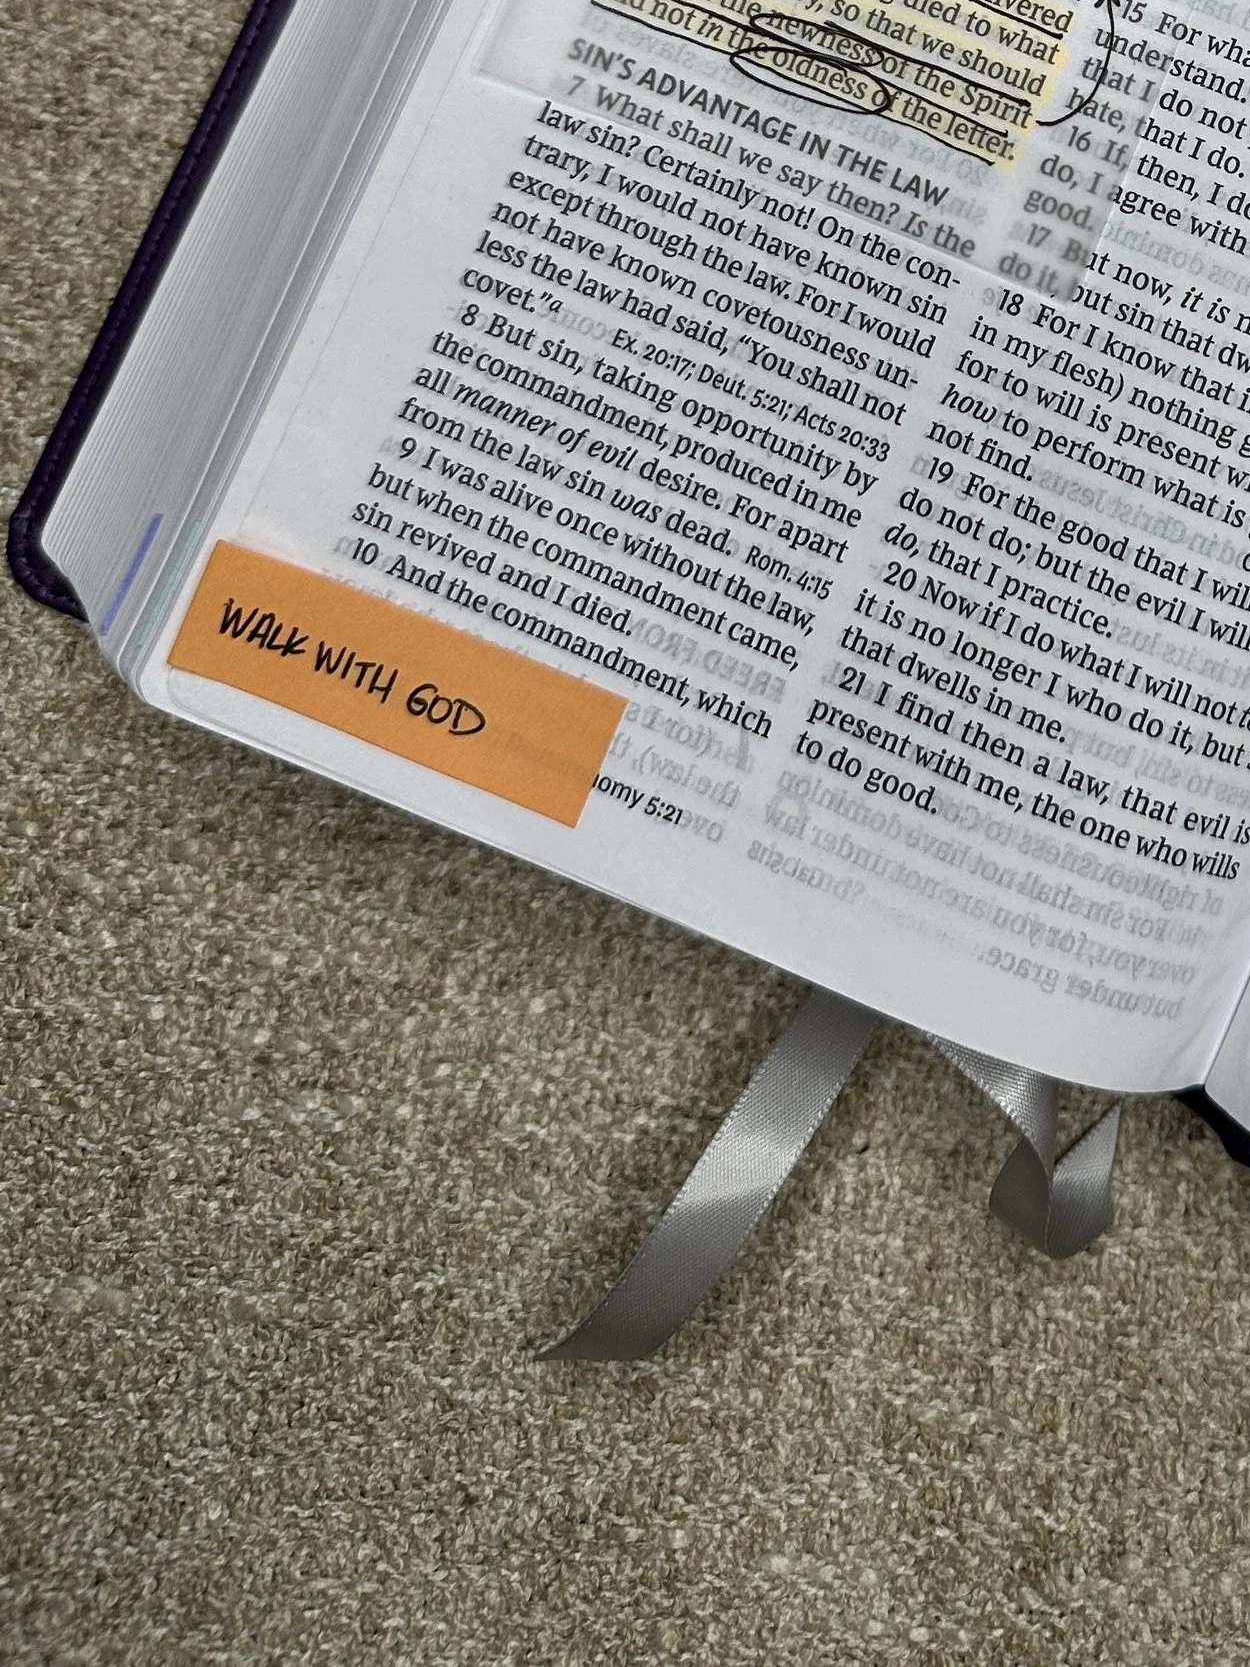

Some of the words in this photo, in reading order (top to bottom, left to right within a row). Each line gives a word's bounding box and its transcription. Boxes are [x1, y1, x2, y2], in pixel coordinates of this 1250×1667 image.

[636, 68, 797, 146] ADVANTAGE
[799, 131, 831, 160] IN
[837, 144, 888, 183] THE
[889, 167, 950, 206] LAW
[352, 537, 379, 565] 10
[385, 554, 446, 594] And
[445, 578, 488, 613] the
[491, 602, 690, 707] commandment,
[697, 689, 772, 739] which
[745, 545, 792, 583] Rom.
[795, 570, 834, 600] 4:15
[219, 597, 310, 657] WALK
[314, 640, 399, 704] WITH
[406, 682, 487, 736] GOD
[644, 796, 683, 825] 5:21
[838, 666, 867, 696] 21
[873, 681, 893, 707] I
[895, 691, 955, 735] find
[960, 719, 1024, 767] then
[1033, 755, 1050, 778] a
[1056, 759, 1110, 806] law,
[1121, 785, 1178, 825] that
[1183, 812, 1231, 840] evil
